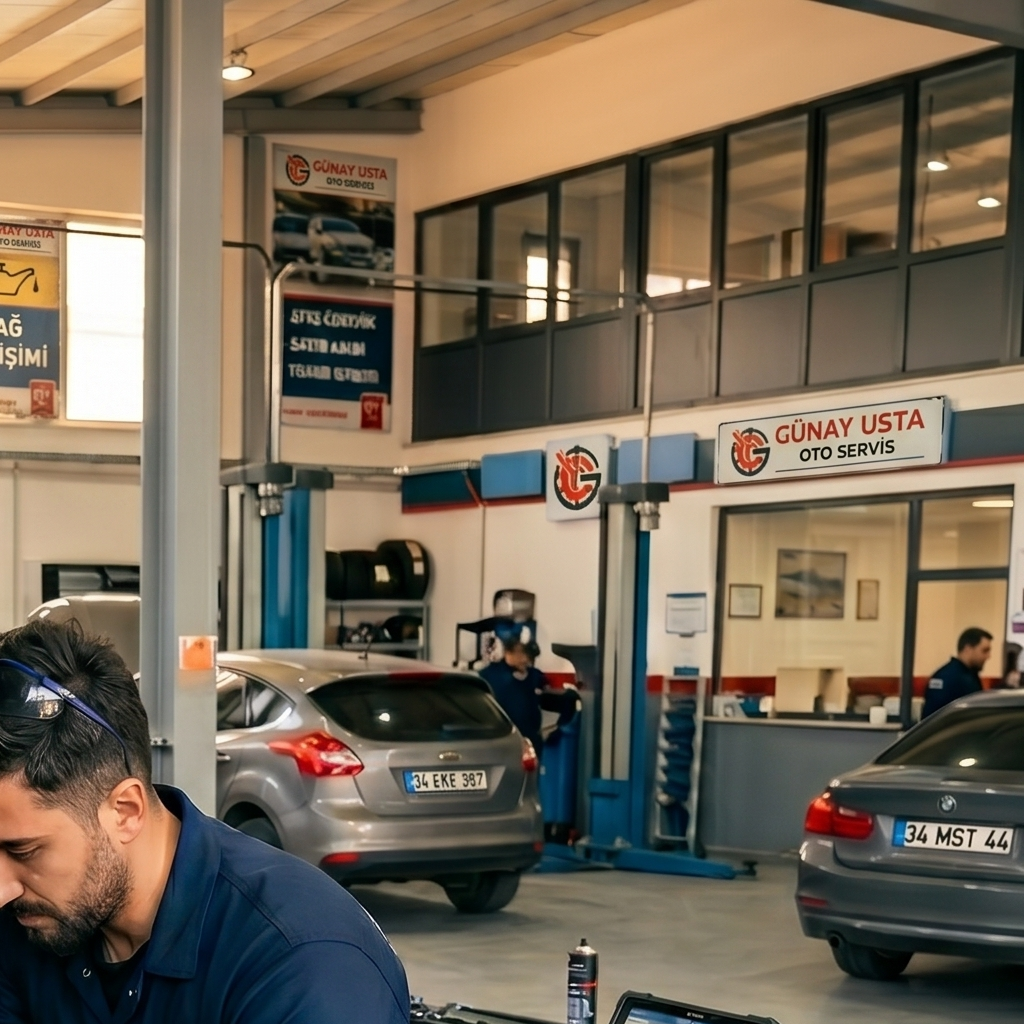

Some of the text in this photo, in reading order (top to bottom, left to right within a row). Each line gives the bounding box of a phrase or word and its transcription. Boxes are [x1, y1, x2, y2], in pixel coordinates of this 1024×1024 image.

[313, 160, 388, 181] GÜNAY USTA
[775, 409, 925, 445] GÜNAY USTA
[799, 437, 895, 462] OTO SERVİS
[414, 774, 429, 789] 34
[433, 773, 456, 788] EKE
[904, 825, 1009, 851] 34 MST 44
